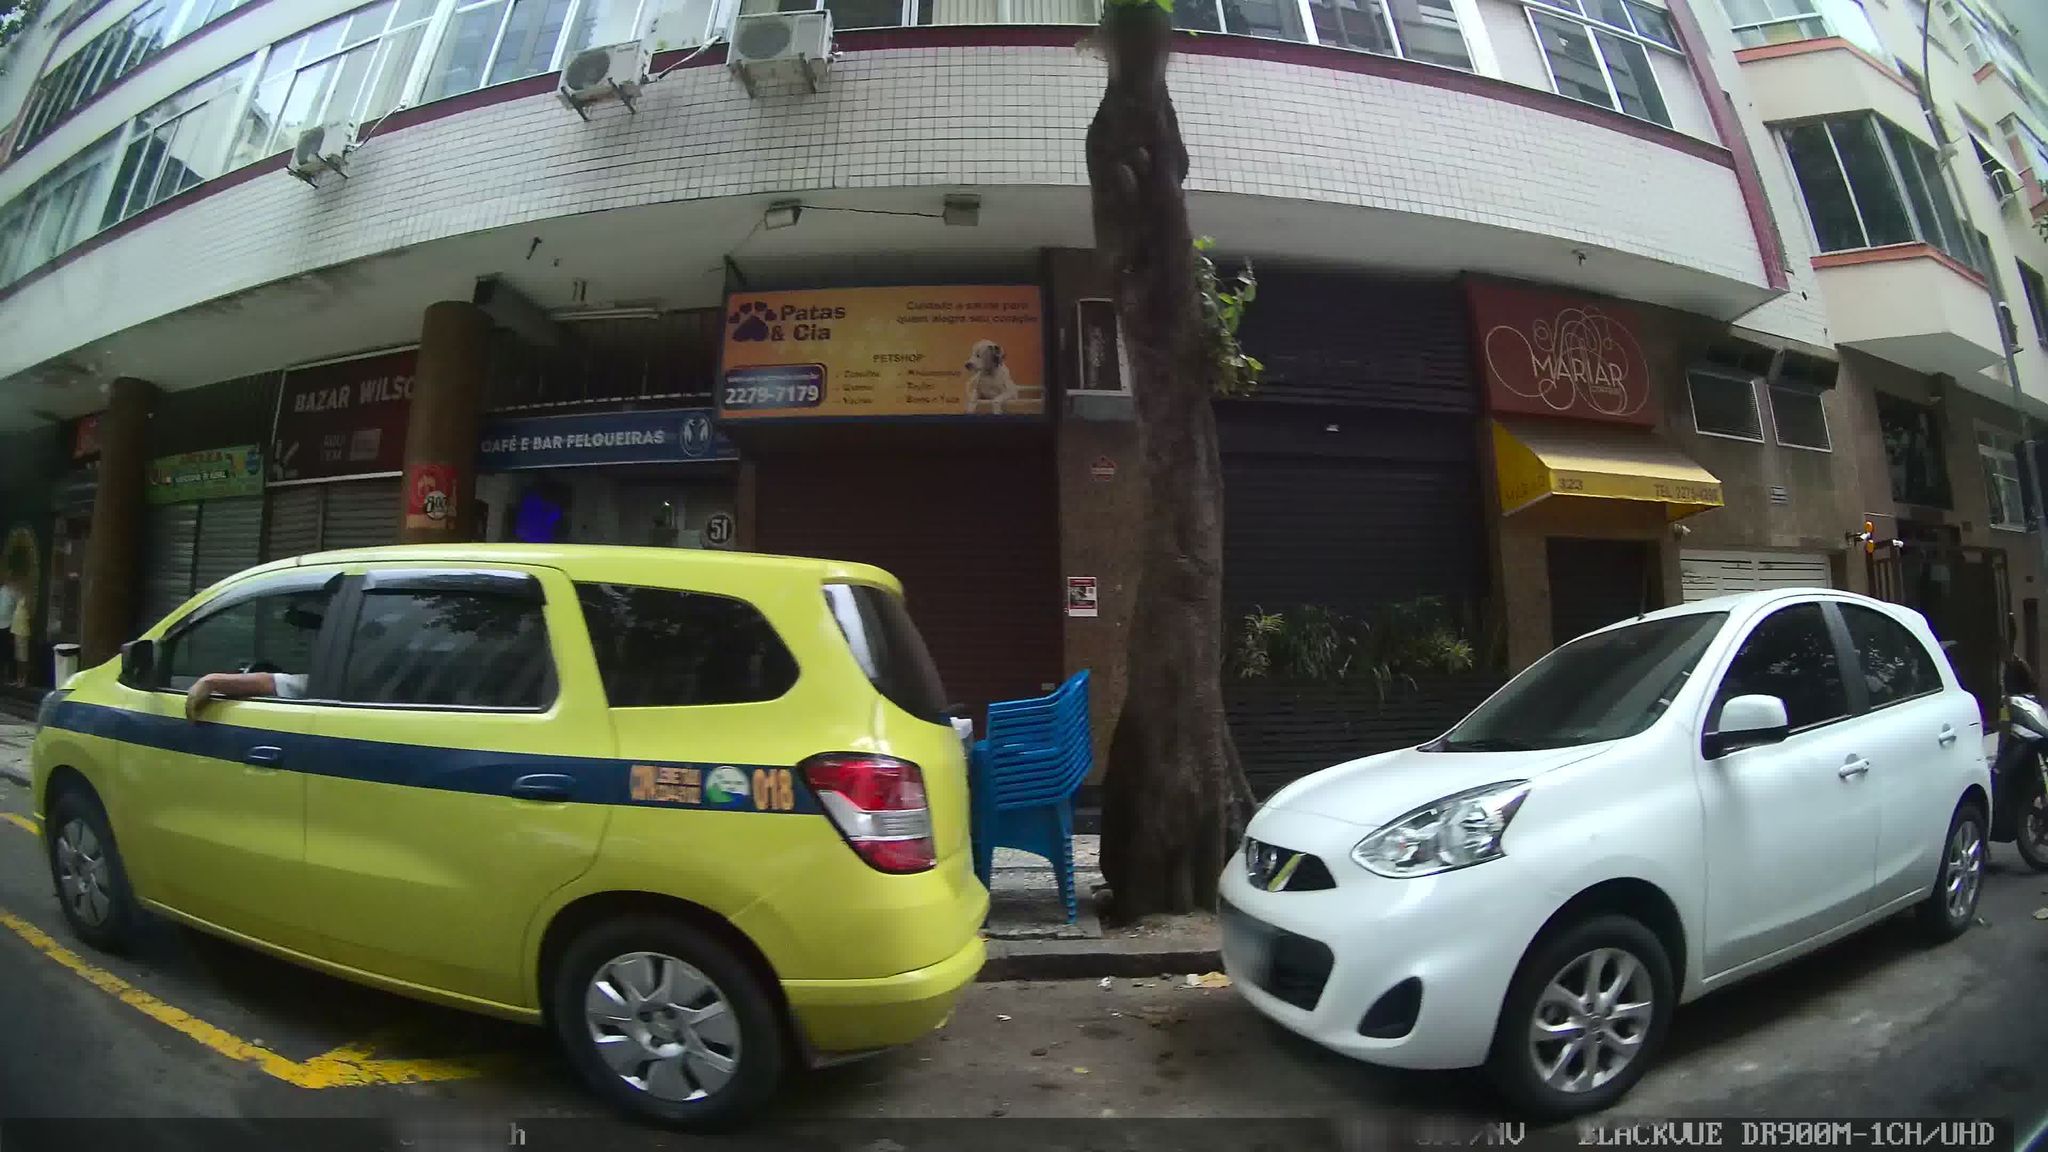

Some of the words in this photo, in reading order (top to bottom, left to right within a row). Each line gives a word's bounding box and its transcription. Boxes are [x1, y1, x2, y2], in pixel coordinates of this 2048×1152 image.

[781, 304, 846, 321] Patas
[771, 325, 785, 341] &
[793, 324, 832, 341] Cia
[873, 353, 924, 363] PETSHOP
[294, 384, 351, 413] BAZAR
[725, 385, 819, 404] 2279-7179
[480, 435, 516, 453] CAFÉ
[520, 437, 530, 452] E
[533, 436, 563, 451] BAR
[567, 430, 666, 449] FELGUEIRAS
[710, 518, 729, 540] 51
[753, 767, 795, 812] 018
